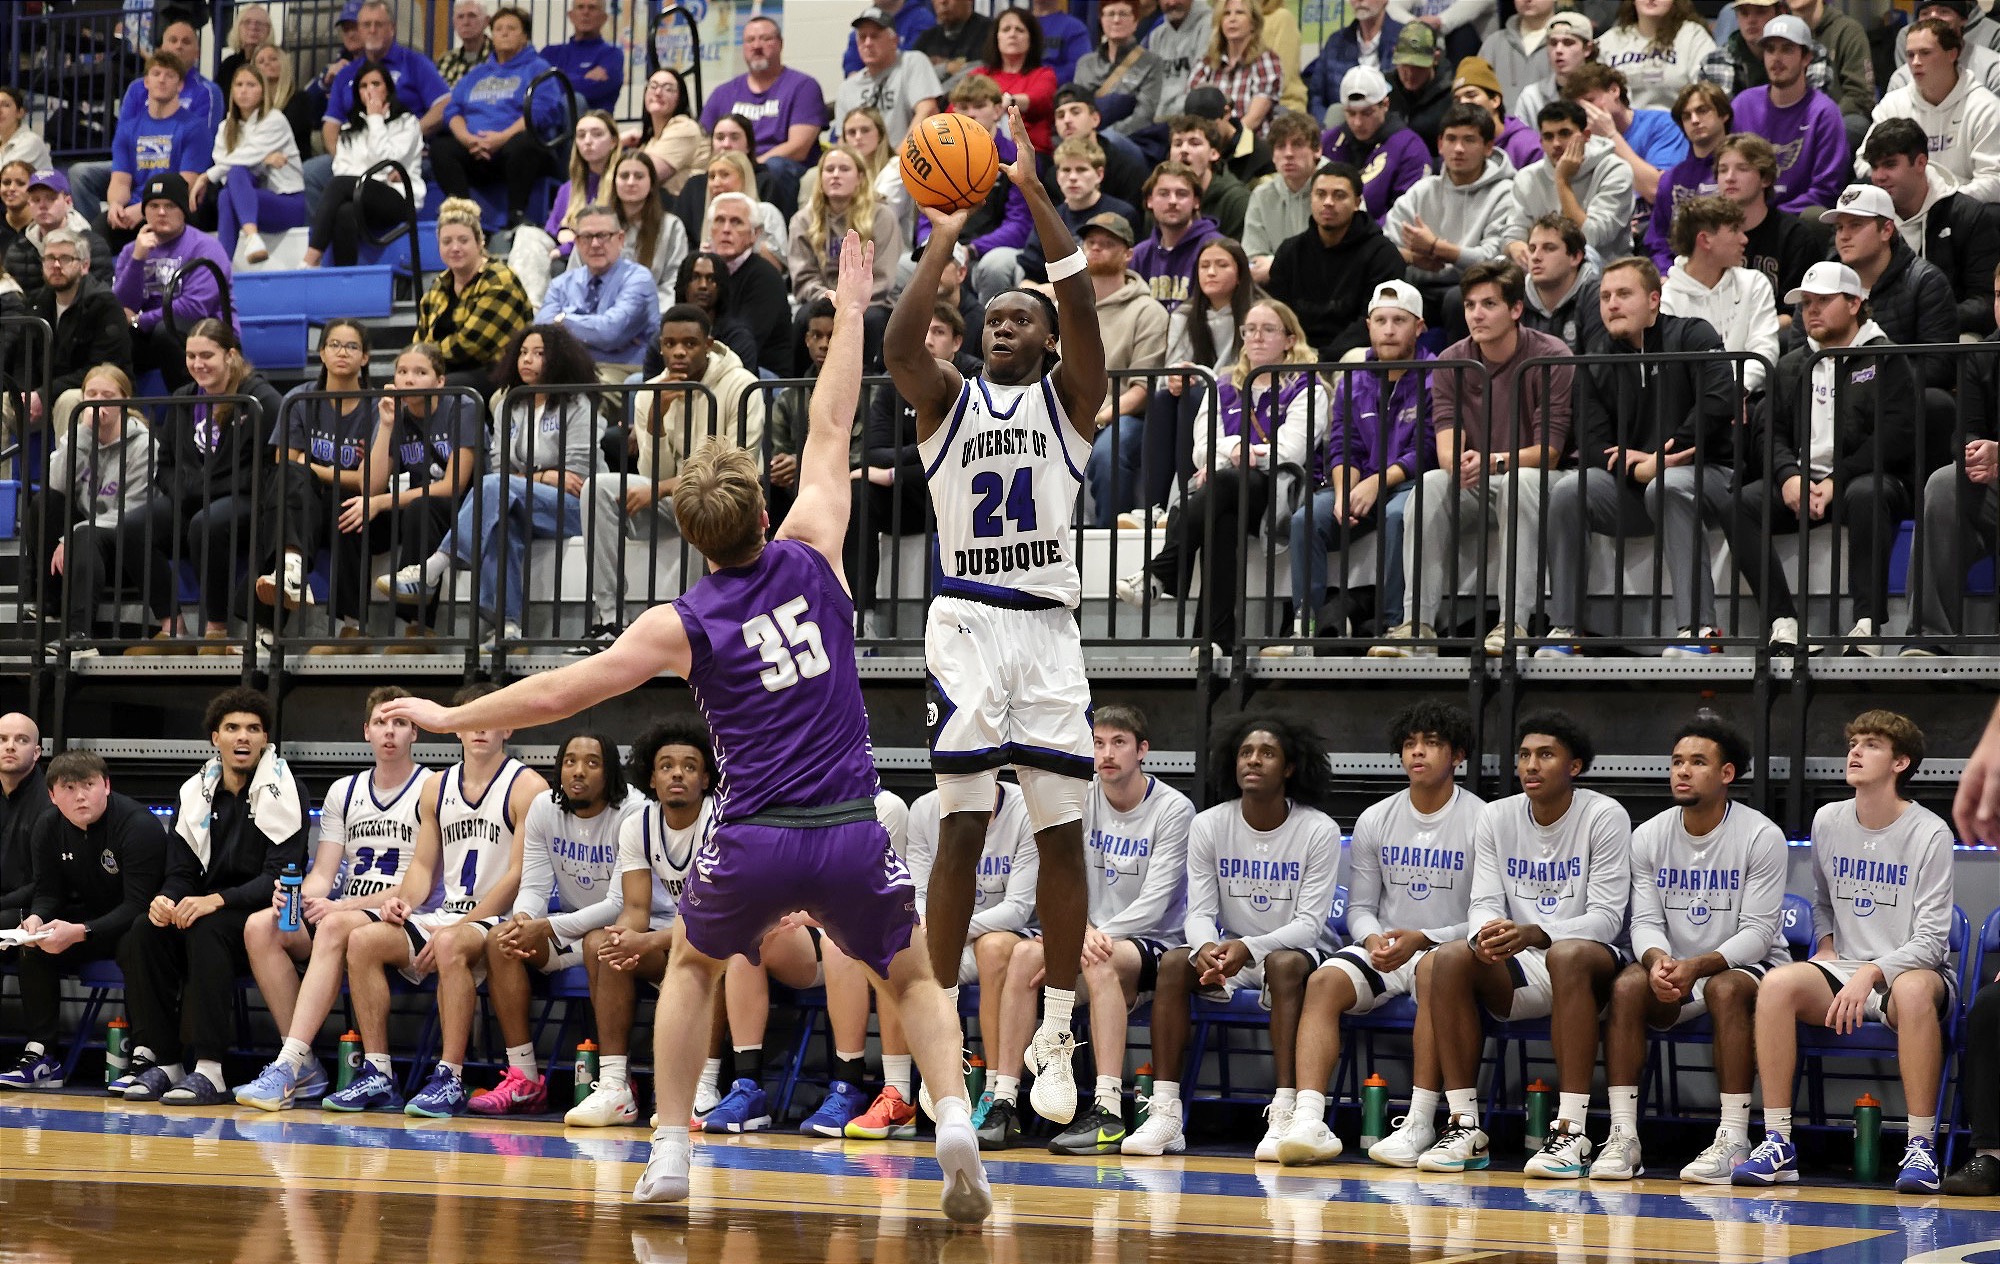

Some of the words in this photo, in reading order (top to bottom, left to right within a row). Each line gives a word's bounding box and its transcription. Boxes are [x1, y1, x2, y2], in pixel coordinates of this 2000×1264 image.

[906, 134, 933, 181] Wilso
[1032, 429, 1047, 459] OF
[971, 466, 1038, 539] 24
[955, 539, 1063, 577] DUBUQUE
[741, 594, 831, 693] 35
[401, 823, 413, 844] OF
[489, 822, 501, 845] OF
[353, 846, 400, 877] 34
[460, 849, 479, 897] 4
[1219, 858, 1300, 881] SPARTANS
[1381, 846, 1465, 871] SPARTANS
[1832, 856, 1909, 886] SPARTANS
[1656, 868, 1740, 891] SPARTANS
[290, 885, 299, 925] POWERADE
